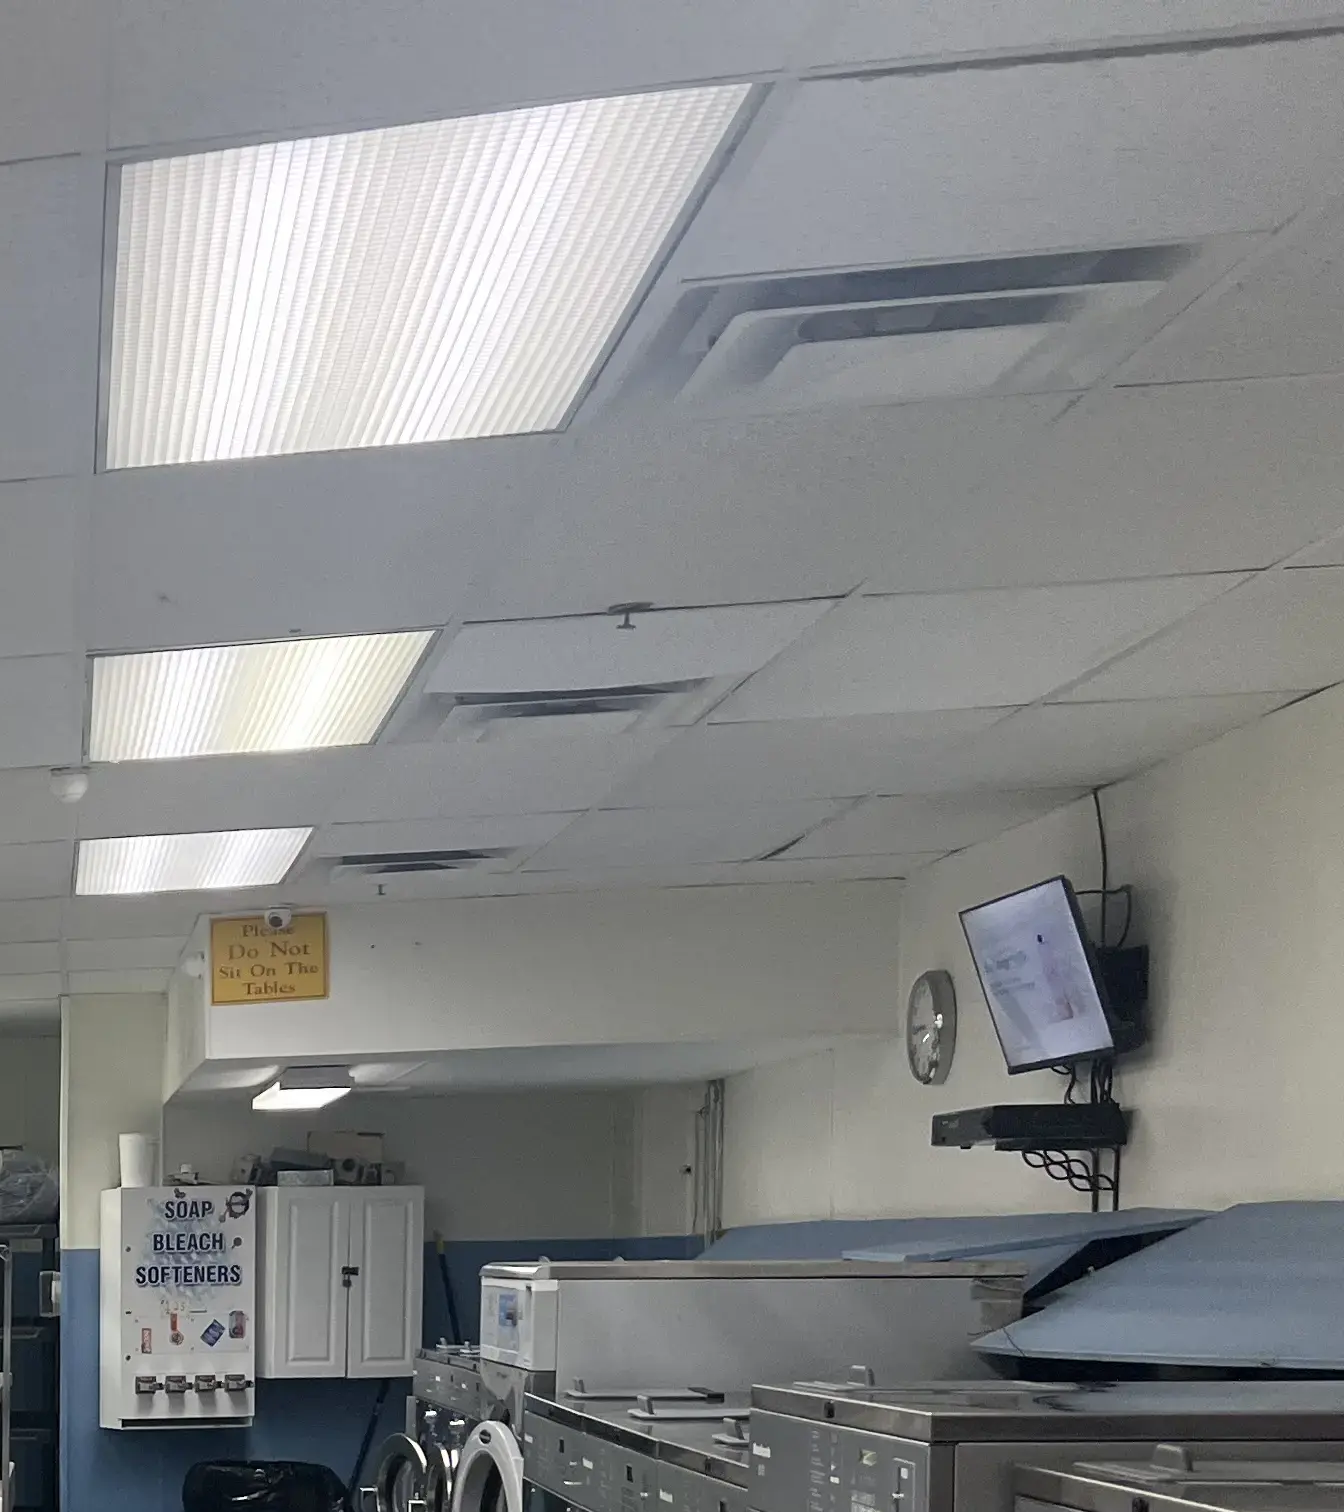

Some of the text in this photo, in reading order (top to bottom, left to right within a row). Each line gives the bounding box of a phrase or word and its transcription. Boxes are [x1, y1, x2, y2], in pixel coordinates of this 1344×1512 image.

[240, 923, 296, 938] Please
[228, 940, 312, 961] Do Not
[218, 961, 319, 979] Sit On The
[242, 981, 296, 995] Tables
[164, 1200, 214, 1221] SOAP
[152, 1232, 225, 1253] BLEACH
[135, 1264, 243, 1286] SOFTENERS
